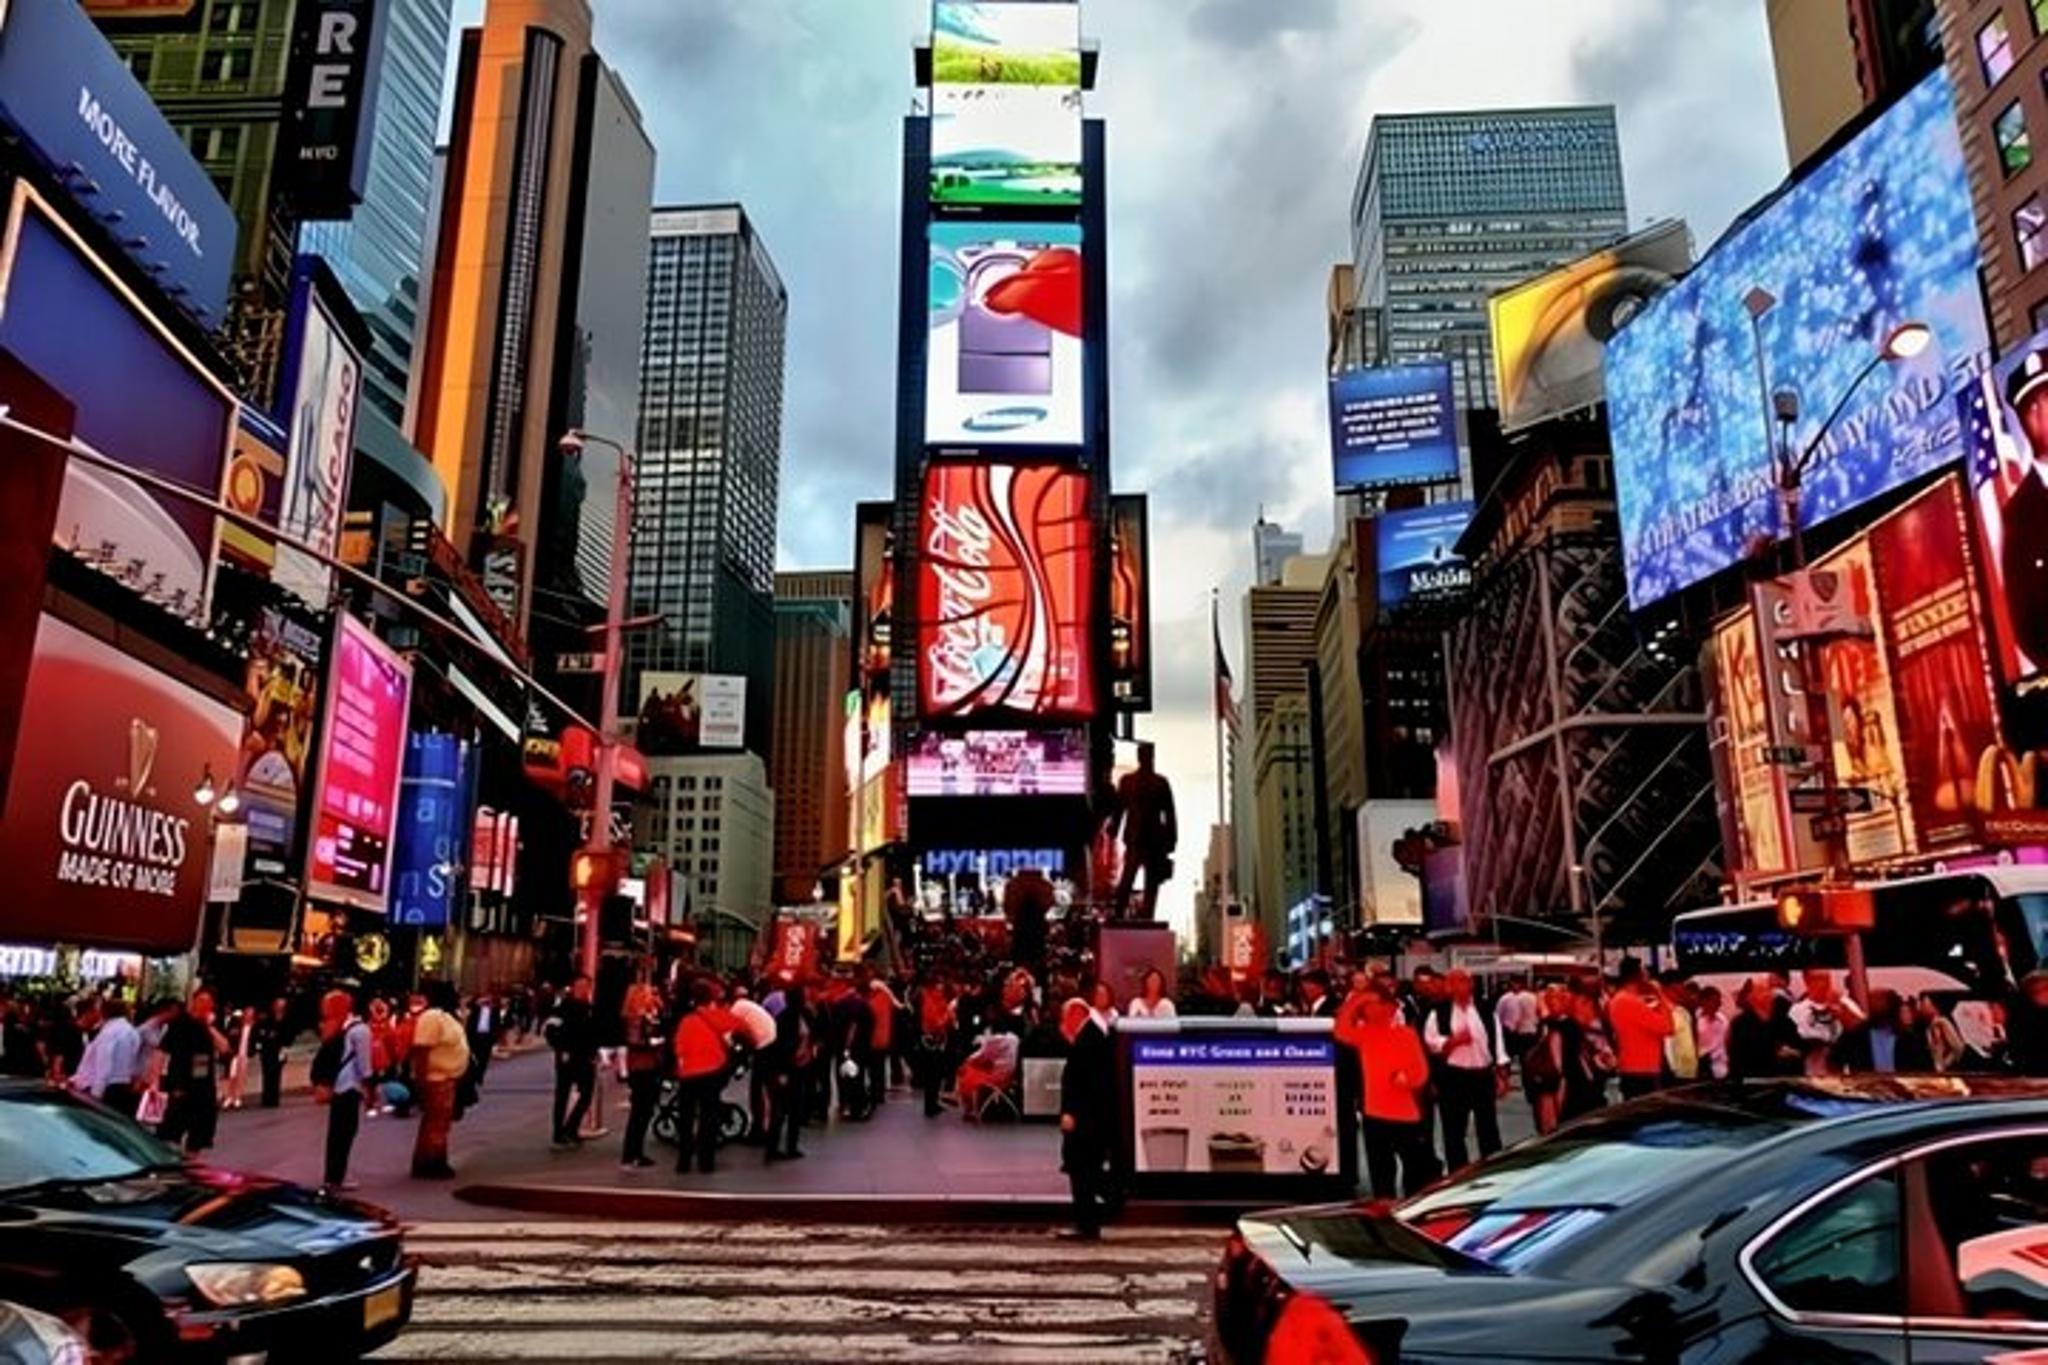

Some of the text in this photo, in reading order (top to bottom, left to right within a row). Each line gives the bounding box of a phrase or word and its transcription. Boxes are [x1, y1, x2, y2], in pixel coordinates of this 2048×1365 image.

[78, 85, 139, 176] MORE
[60, 778, 190, 868] GUINNESS
[57, 850, 177, 897] MADE OF MORE
